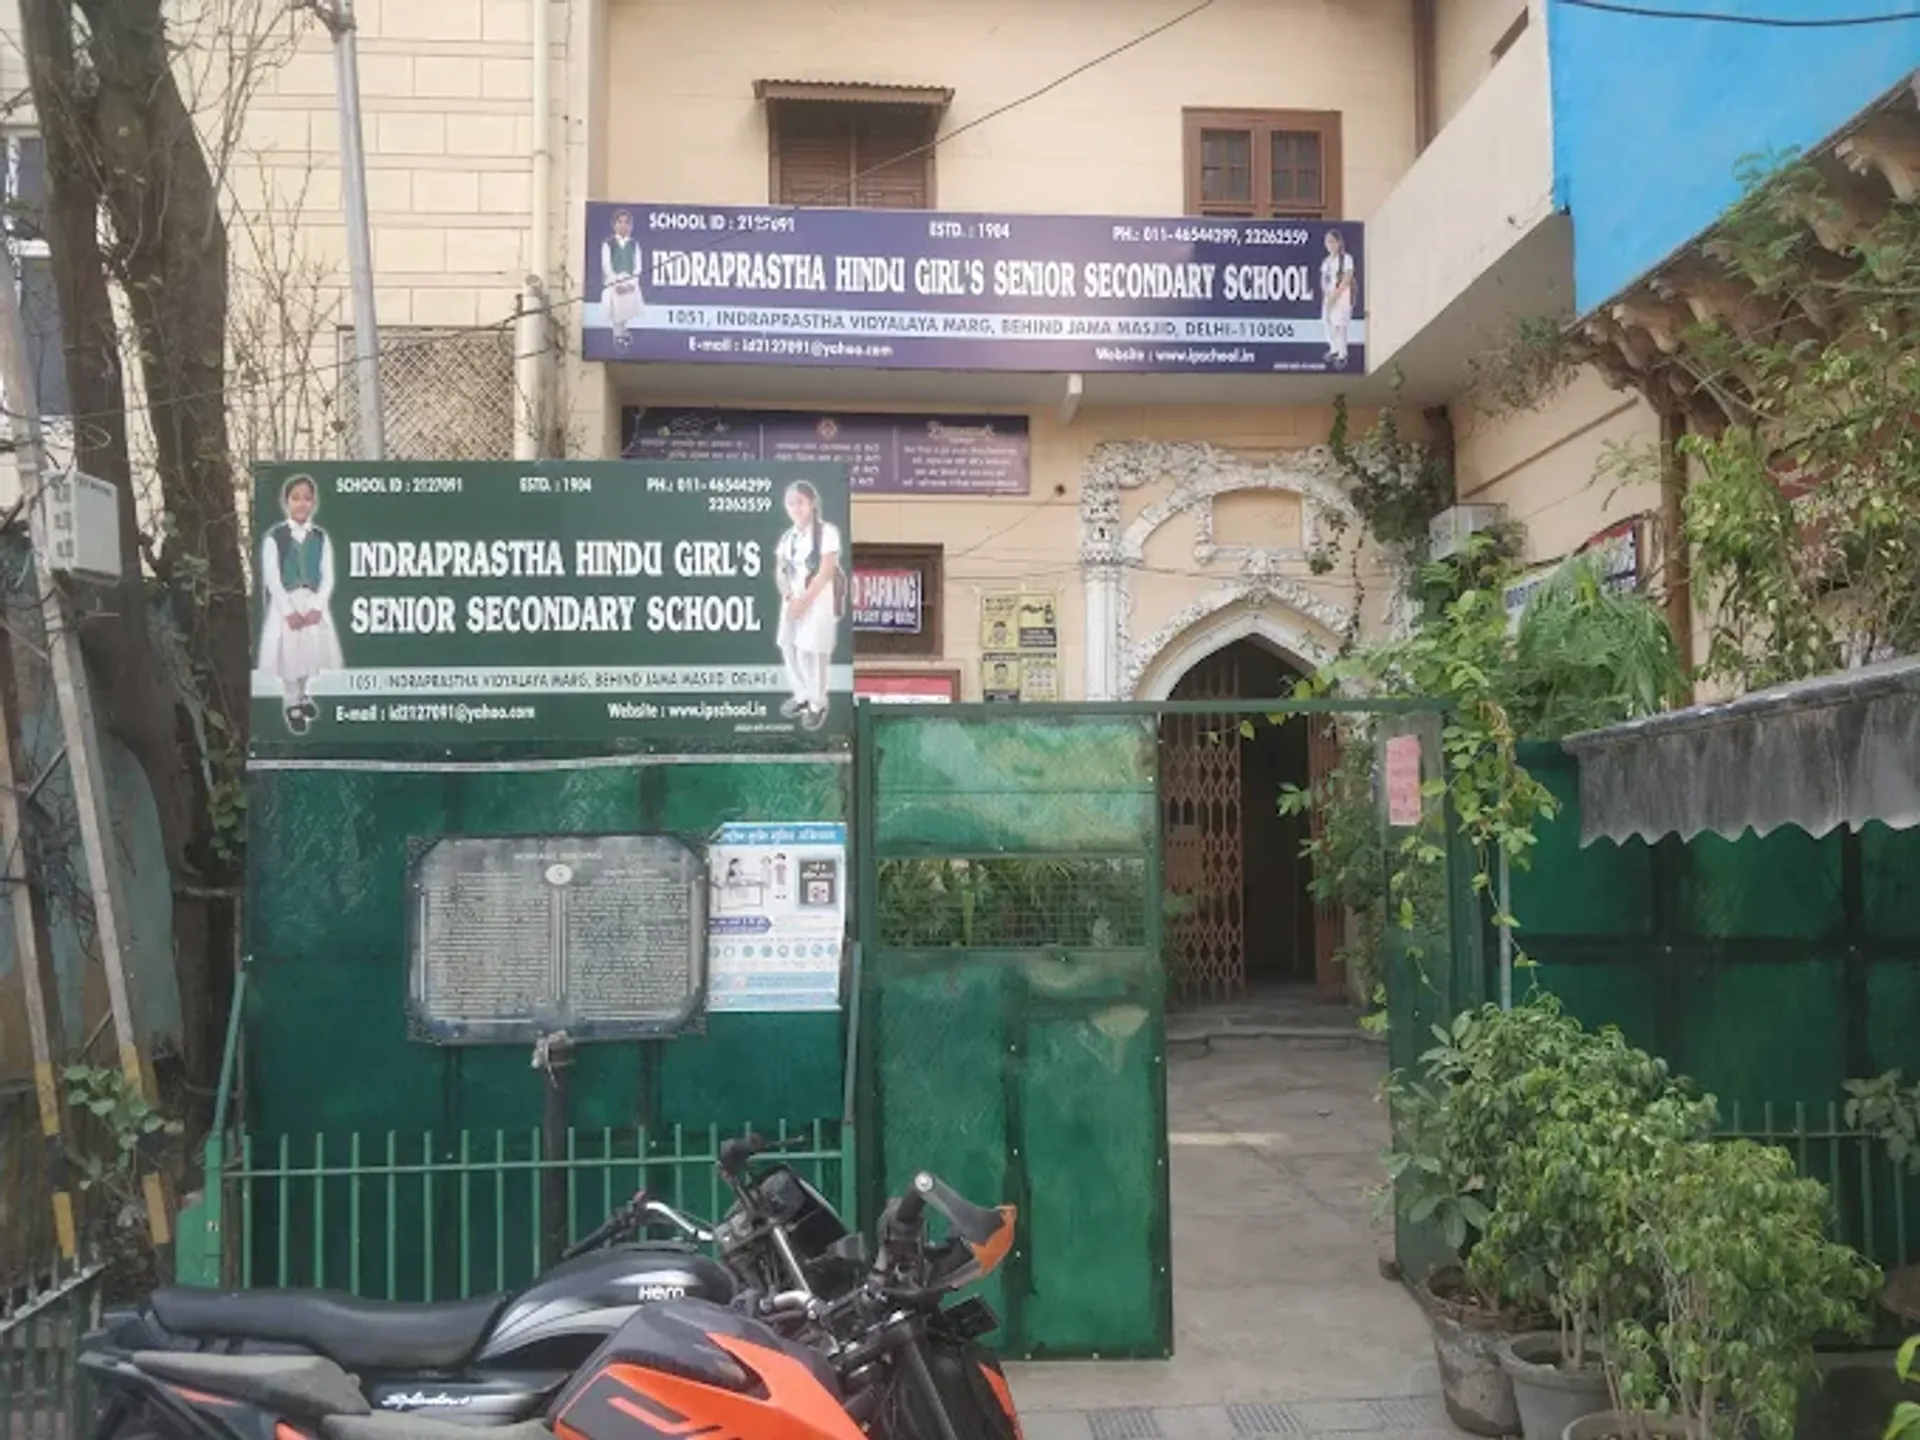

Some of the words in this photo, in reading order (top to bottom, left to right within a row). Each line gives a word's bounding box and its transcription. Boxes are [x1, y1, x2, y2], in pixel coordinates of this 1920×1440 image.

[649, 212, 706, 230] SCHOOL
[709, 213, 726, 230] ID
[978, 222, 1011, 239] 1904
[651, 249, 827, 291] INDRAPRASTHA
[835, 255, 906, 294] HINDU
[914, 257, 985, 297] GIRL'S
[993, 259, 1076, 299] SENIOR
[1083, 261, 1216, 301] SECONDARY
[1223, 263, 1314, 302] SCHOOL
[667, 309, 711, 327] 1051,
[717, 310, 846, 329] INDRAPRASTHA
[850, 315, 938, 332] VIDYALAYA
[943, 318, 996, 335] MARG,
[1001, 318, 1064, 336] BEHIND
[1067, 321, 1112, 336] JAMA
[1185, 321, 1295, 338] DELHI-110006
[1094, 346, 1144, 362] Website
[336, 476, 387, 494] SCHOOL
[389, 476, 403, 493] ID
[562, 476, 592, 493] 1904
[350, 540, 565, 578] INDRAPRASTHA
[576, 541, 662, 577] HINDU
[674, 540, 761, 577] GIRL'S
[351, 597, 456, 634] SENIOR
[467, 596, 636, 633] SECONDARY
[647, 596, 761, 633] SCHOOL
[388, 673, 480, 689] INDRAPRASTHA
[483, 673, 549, 688] VIDYALAYA
[595, 671, 642, 687] BEHIND
[646, 671, 677, 686] JAMA
[607, 701, 658, 719] Website
